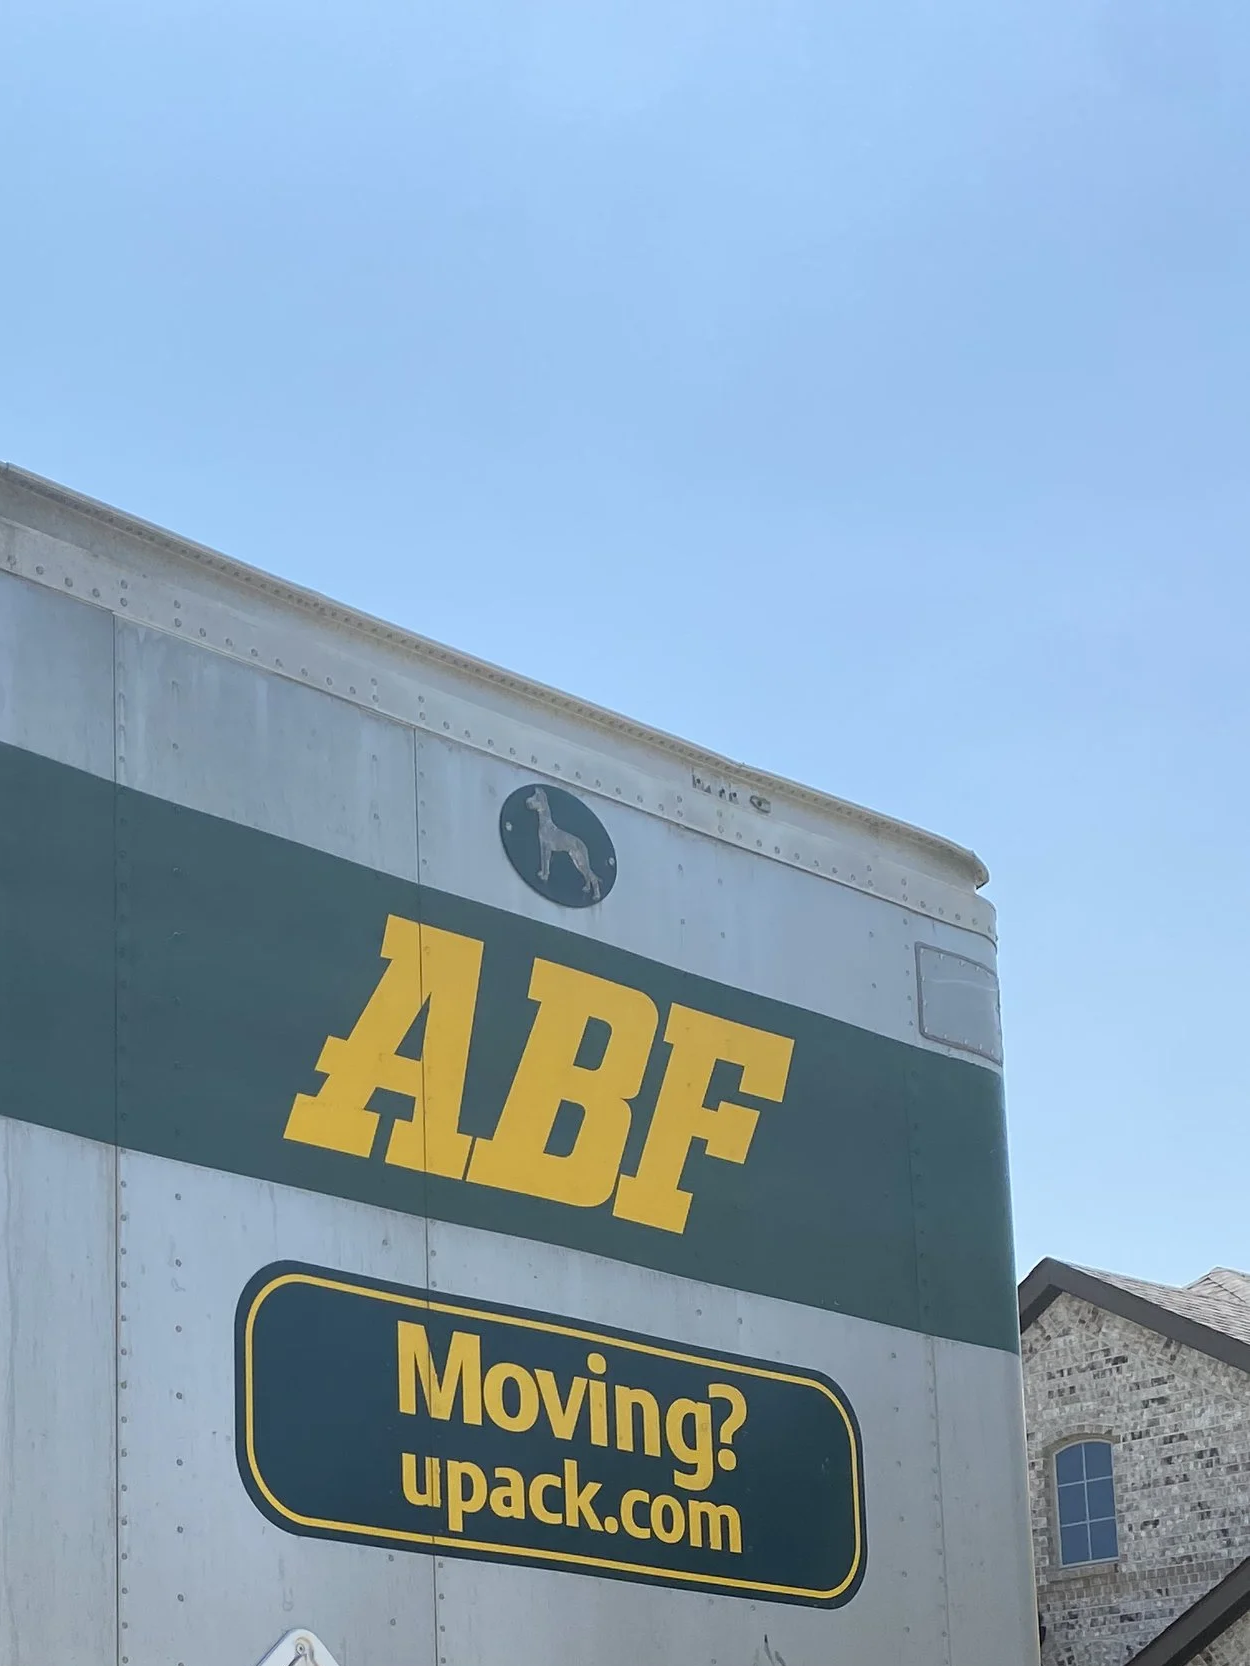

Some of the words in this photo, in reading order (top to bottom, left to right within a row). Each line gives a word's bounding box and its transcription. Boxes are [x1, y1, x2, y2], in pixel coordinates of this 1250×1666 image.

[282, 913, 795, 1234] ABF
[396, 1319, 748, 1492] Moving?
[400, 1450, 744, 1554] upack.com
